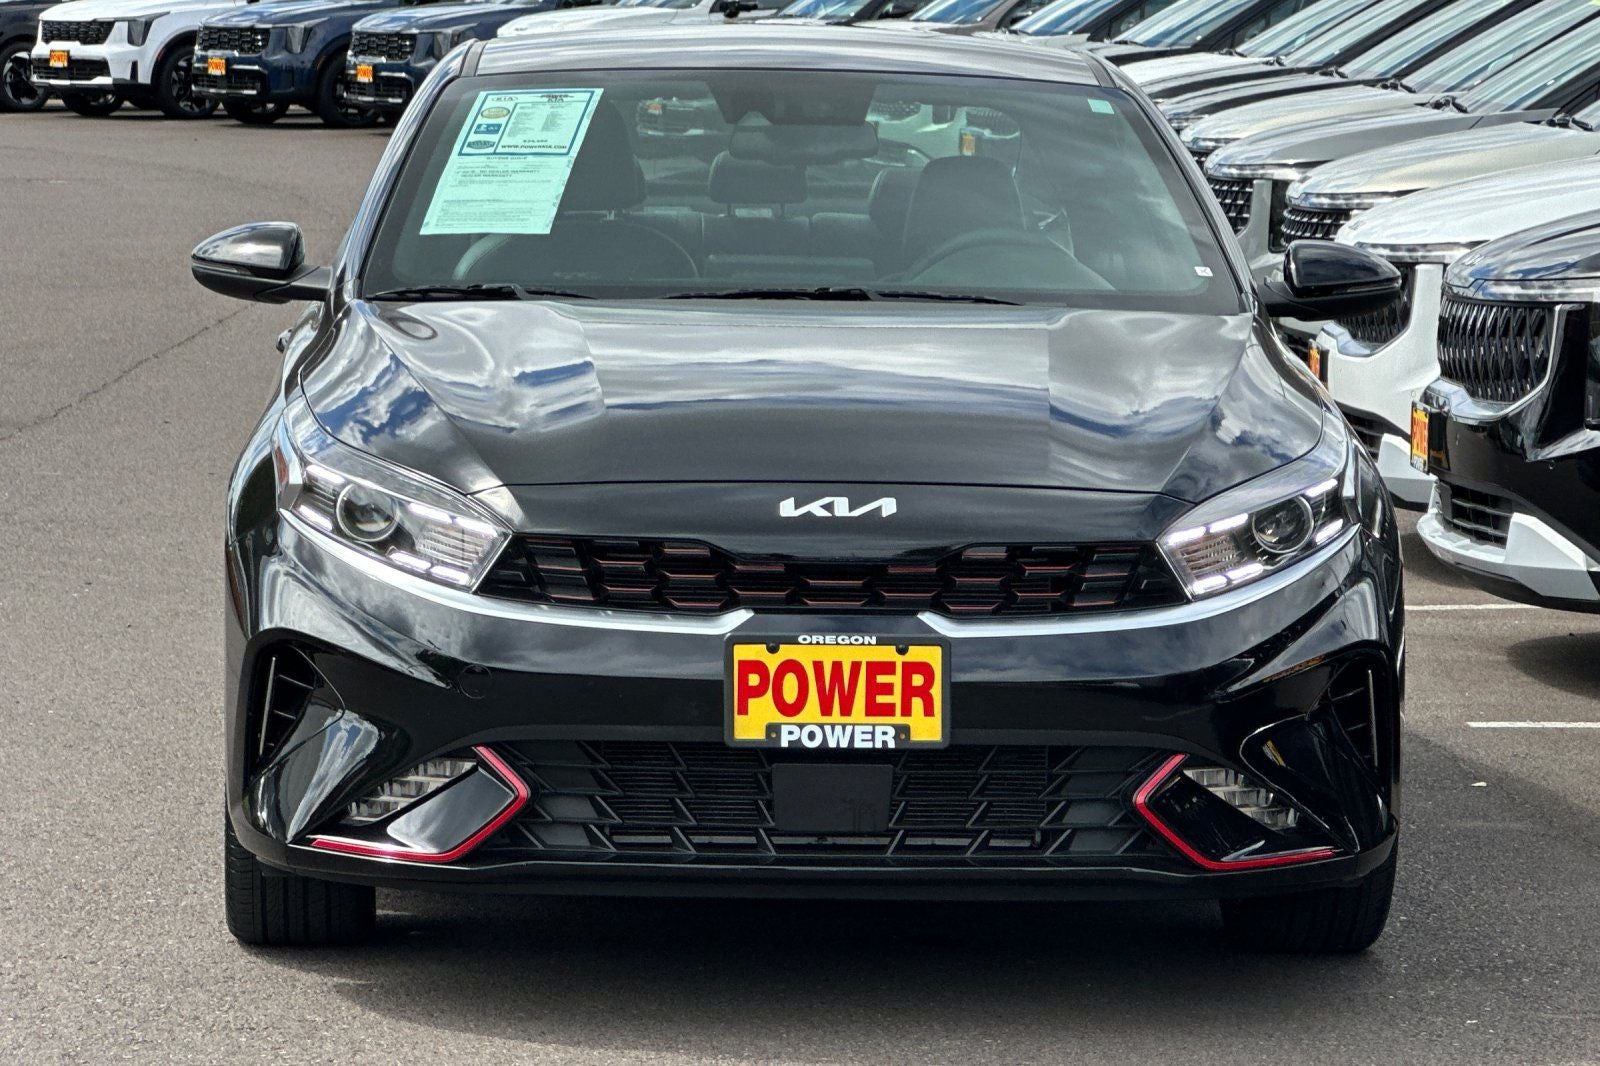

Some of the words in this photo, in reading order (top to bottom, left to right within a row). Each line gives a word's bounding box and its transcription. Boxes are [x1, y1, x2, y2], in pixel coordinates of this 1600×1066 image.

[779, 496, 897, 518] KIA
[797, 634, 877, 645] OREGON
[736, 658, 936, 718] POWER
[780, 724, 896, 749] POWER
